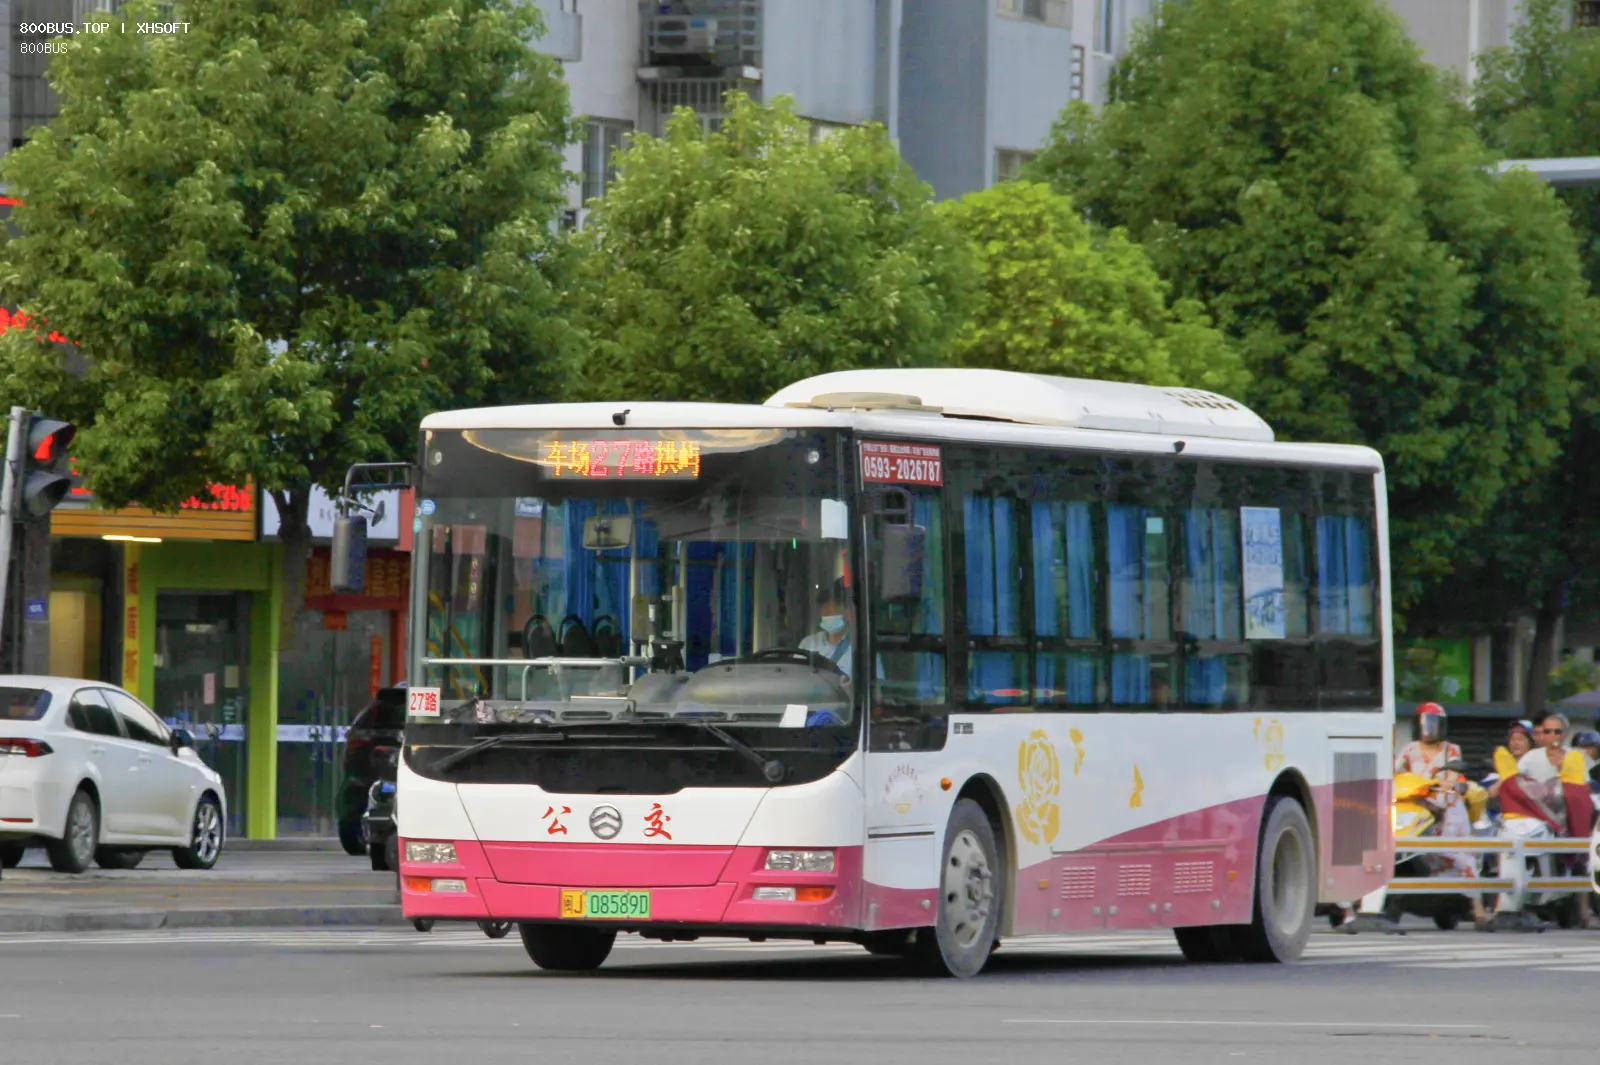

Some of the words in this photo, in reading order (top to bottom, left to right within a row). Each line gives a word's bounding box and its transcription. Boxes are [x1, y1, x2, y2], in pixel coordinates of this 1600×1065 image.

[863, 456, 941, 482] 0593-2026787
[410, 692, 437, 712] 27路
[541, 805, 571, 835] 公
[643, 803, 673, 840] 交
